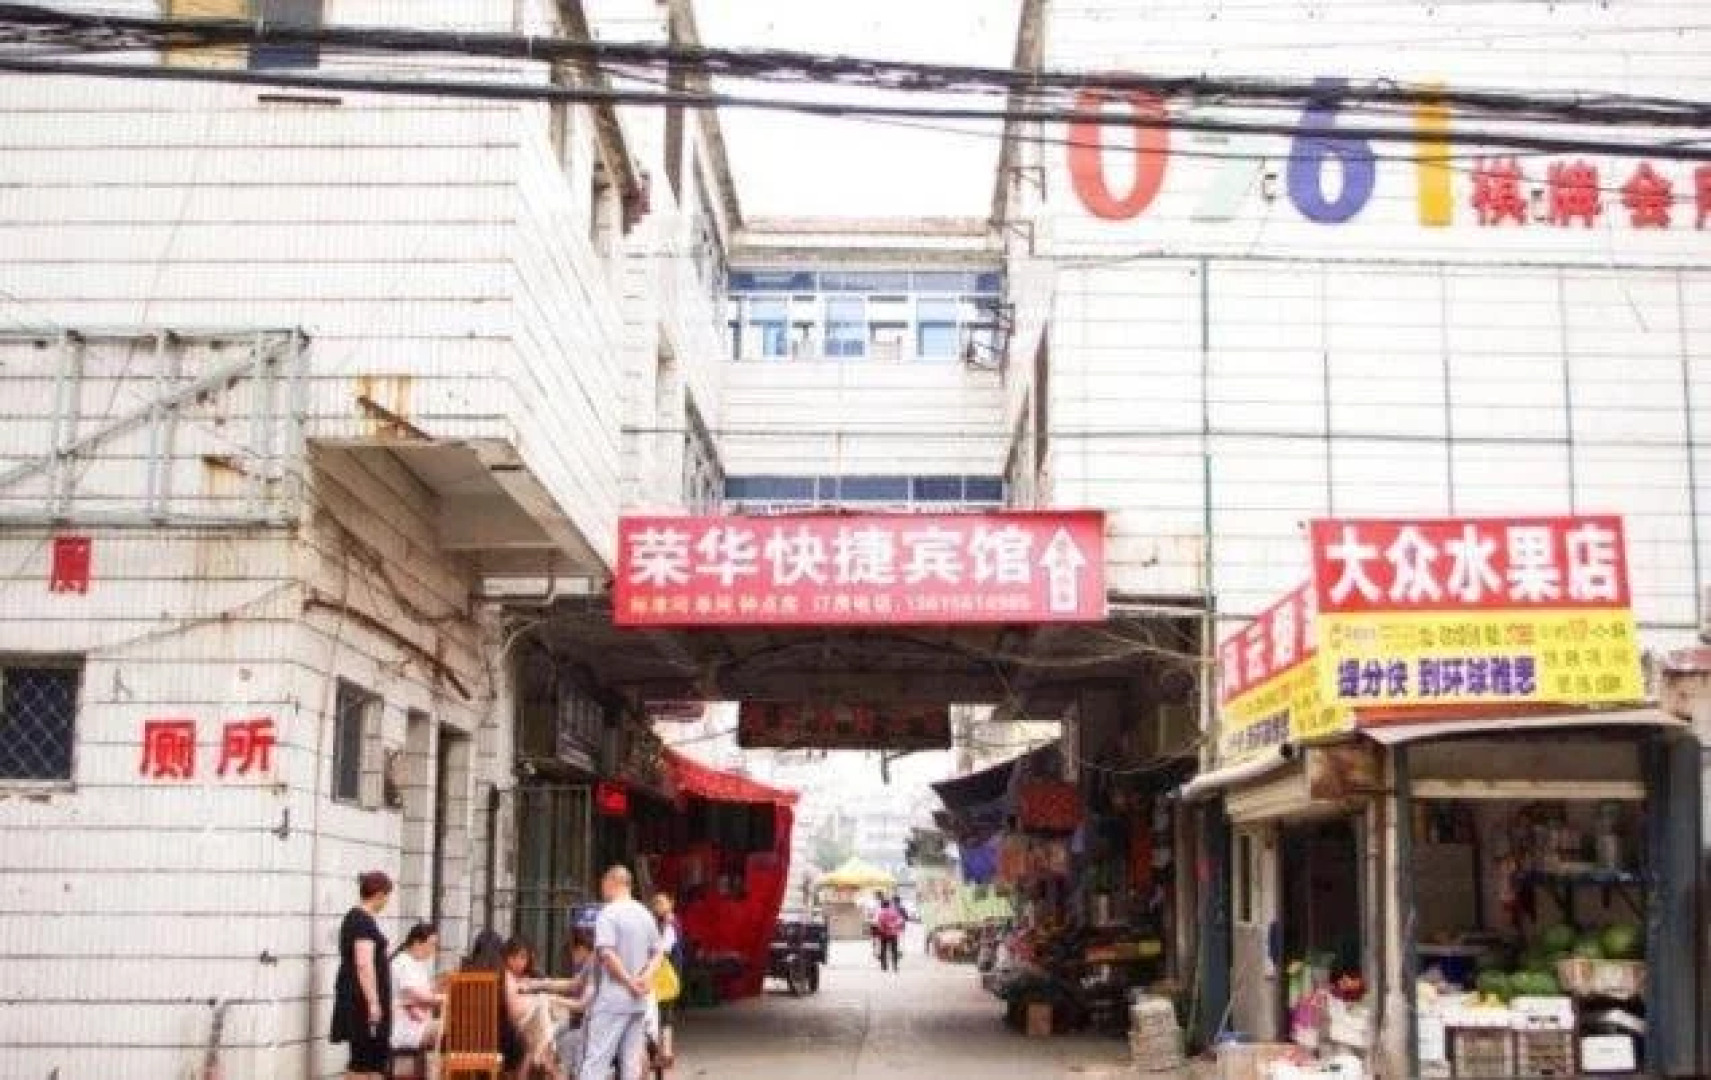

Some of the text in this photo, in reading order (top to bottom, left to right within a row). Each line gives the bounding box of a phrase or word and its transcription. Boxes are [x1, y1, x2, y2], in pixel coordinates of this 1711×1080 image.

[628, 525, 1034, 586] 荣华快捷宾馆
[1325, 523, 1621, 604] 大众水果店
[139, 716, 276, 779] 厕所
